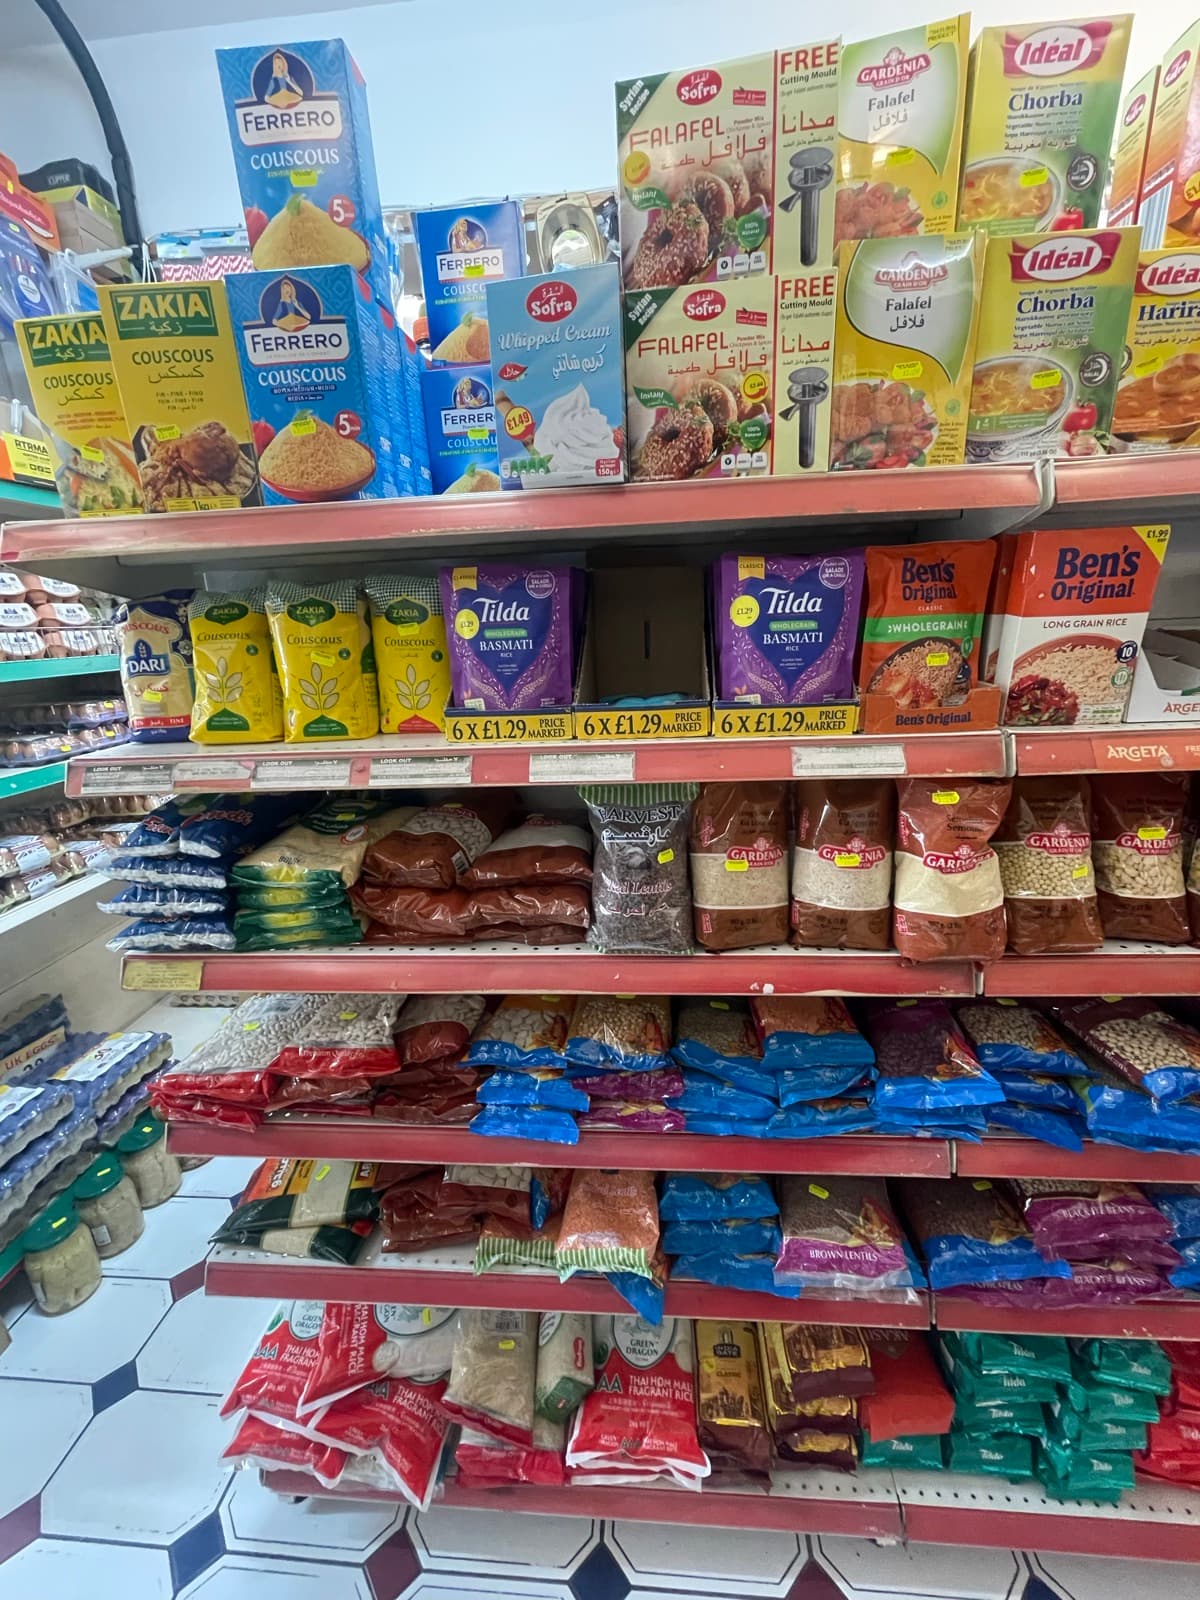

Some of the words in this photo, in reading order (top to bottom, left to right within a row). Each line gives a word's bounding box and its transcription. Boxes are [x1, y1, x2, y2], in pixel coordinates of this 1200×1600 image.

[780, 42, 839, 74] FREE
[1019, 37, 1086, 66] Idéal
[779, 72, 809, 86] Cutting
[811, 67, 838, 80] Mould
[860, 56, 927, 82] GARDENIA
[619, 80, 645, 113] Syrian
[680, 84, 718, 102] Sofra
[868, 89, 915, 112] Falafel
[1008, 90, 1083, 111] Chorba
[243, 110, 336, 133] FERRERO
[872, 109, 908, 132] فلافل
[333, 199, 344, 221] 5
[439, 256, 500, 272] FERRERO
[1028, 246, 1095, 272] Idéal
[877, 263, 944, 282] GARDENIA
[1147, 263, 1200, 286] Idéa
[781, 275, 835, 300] FREE
[117, 293, 209, 320] ZAKIA
[531, 297, 573, 316] Sofra
[628, 293, 652, 321] Syrian
[687, 302, 722, 318] Sofra
[780, 300, 807, 311] Cutting
[808, 298, 833, 308] Mould
[885, 296, 932, 312] Falafel
[1016, 293, 1095, 314] Chorba
[1138, 301, 1200, 321] Harir
[149, 321, 183, 336] زكية
[890, 314, 925, 333] فلافل
[29, 321, 107, 349] ZAKIA
[251, 333, 342, 352] FERRERO
[498, 327, 560, 351] Whipped
[565, 324, 612, 341] Cream
[132, 348, 214, 366] COUSCOUS
[706, 346, 767, 375] فلافل
[44, 372, 114, 390] COUSCOUS
[148, 365, 205, 384] كسكس
[58, 388, 105, 407] كسكس
[640, 391, 664, 400] Instant
[339, 414, 351, 436] 5
[444, 412, 496, 426] FERRER
[507, 411, 530, 430] £1.49
[1147, 530, 1169, 538] £1.99
[901, 557, 955, 584] Ben's
[1054, 545, 1141, 579] Ben's
[902, 584, 957, 603] Original
[1051, 578, 1133, 604] Original
[296, 605, 326, 614] ZAKIA
[759, 587, 823, 614] Tilda
[918, 604, 943, 612] CLASSIC
[212, 606, 239, 615] ZAKIA
[392, 608, 419, 617] ZAKIA
[472, 597, 531, 623] Tilda
[893, 620, 964, 634] WHOLEGRAIN
[1043, 620, 1071, 629] LONG
[1073, 619, 1103, 628] GRAIN
[1106, 617, 1128, 627] RICE
[479, 639, 534, 651] BASMATI
[763, 632, 823, 645] BASMATI
[1122, 647, 1133, 658] 10
[128, 658, 166, 673] DARI
[539, 717, 566, 729] PRICE
[675, 711, 702, 722] PRICE
[720, 714, 733, 734] 6
[754, 711, 805, 733] £1.29
[819, 709, 847, 721] PRICE
[895, 713, 924, 726] Ben's
[926, 712, 971, 725] Original
[452, 720, 463, 740] 6
[483, 719, 527, 740] £1.29
[528, 727, 566, 739] MARKED
[583, 718, 595, 736] 6
[615, 714, 662, 735] £1.29
[662, 721, 702, 734] MARKED
[804, 720, 846, 732] MARKED
[1107, 745, 1170, 762] ARGETA
[599, 805, 681, 823] HARVEST
[731, 849, 783, 861] GARDENIA
[810, 1249, 843, 1259] BROWN
[844, 1250, 878, 1262] LENTILS
[626, 1346, 658, 1356] DRAGON
[630, 1339, 655, 1348] GREEN
[630, 1375, 649, 1386] THAI
[649, 1376, 671, 1388] HOM
[628, 1385, 673, 1398] FRAGRANT
[891, 1440, 913, 1451] Tilda
